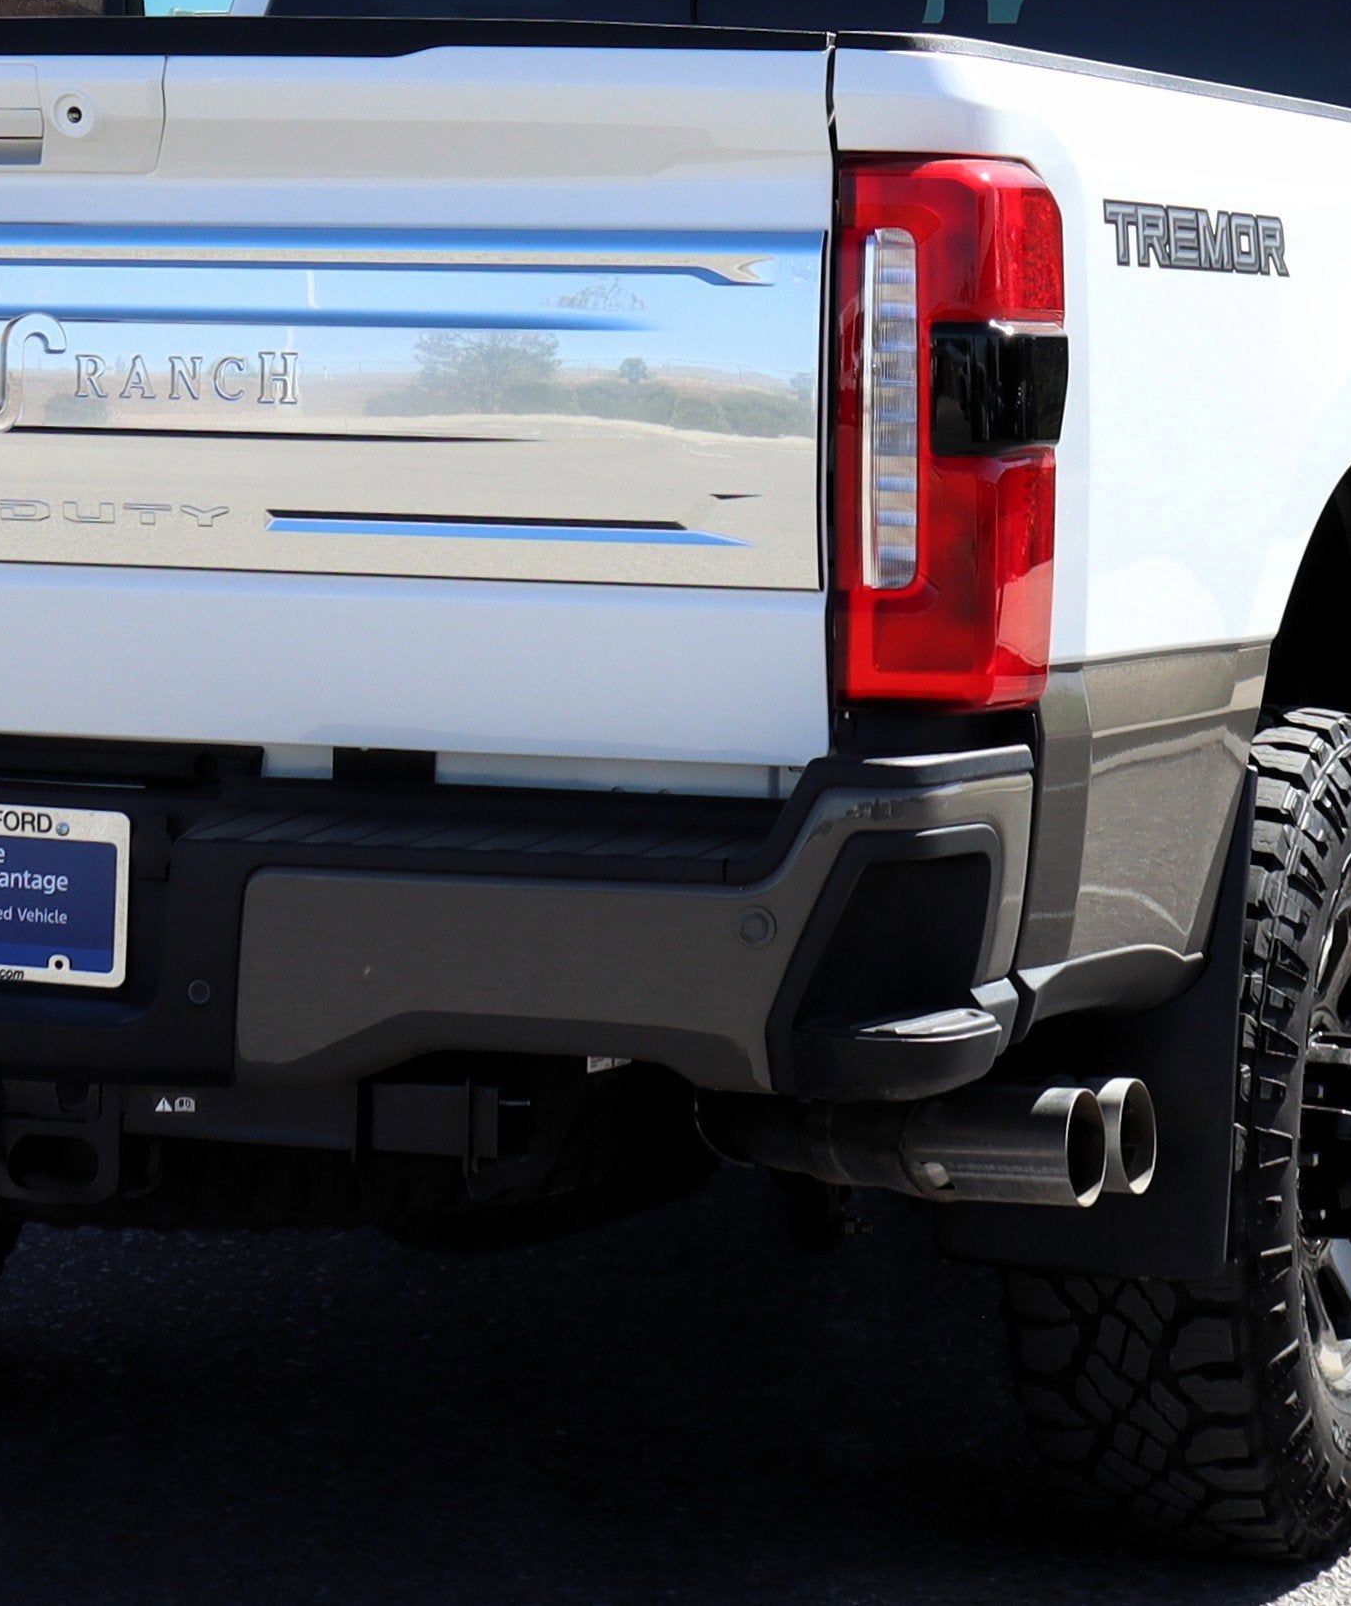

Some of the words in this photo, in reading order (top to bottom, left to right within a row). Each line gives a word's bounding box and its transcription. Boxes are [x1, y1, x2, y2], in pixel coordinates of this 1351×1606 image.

[1103, 198, 1290, 278] TREMOR
[74, 351, 300, 405] RANCH
[0, 498, 230, 528] DUTY
[16, 907, 69, 925] Vehicle
